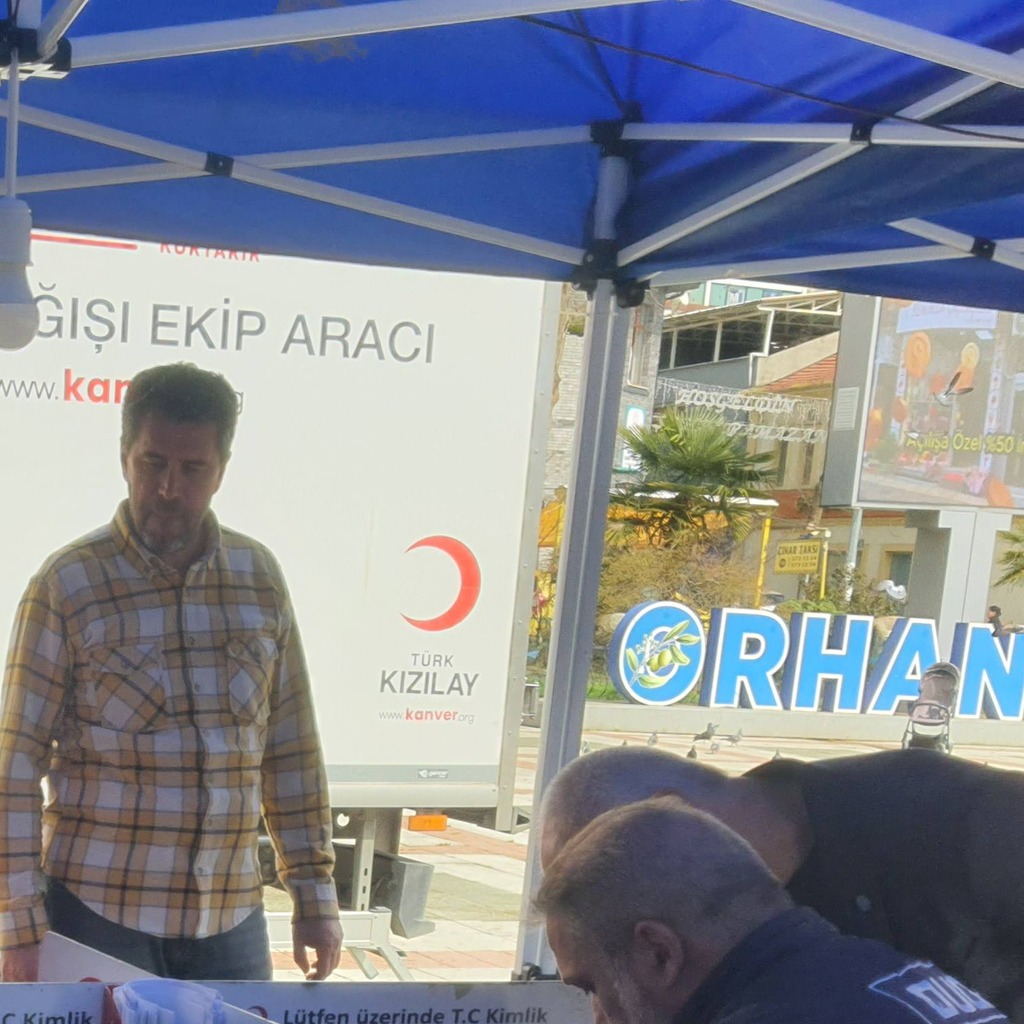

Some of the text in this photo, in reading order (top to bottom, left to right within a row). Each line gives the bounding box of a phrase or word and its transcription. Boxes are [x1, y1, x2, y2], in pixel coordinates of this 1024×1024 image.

[150, 298, 268, 351] EKİP
[281, 314, 436, 364] ARACI
[985, 434, 1014, 453] %50
[411, 650, 454, 667] TÜRK
[380, 670, 479, 696] KIZILAY
[284, 1008, 548, 1024] Lütfen üzerinde T.C Kimlik
